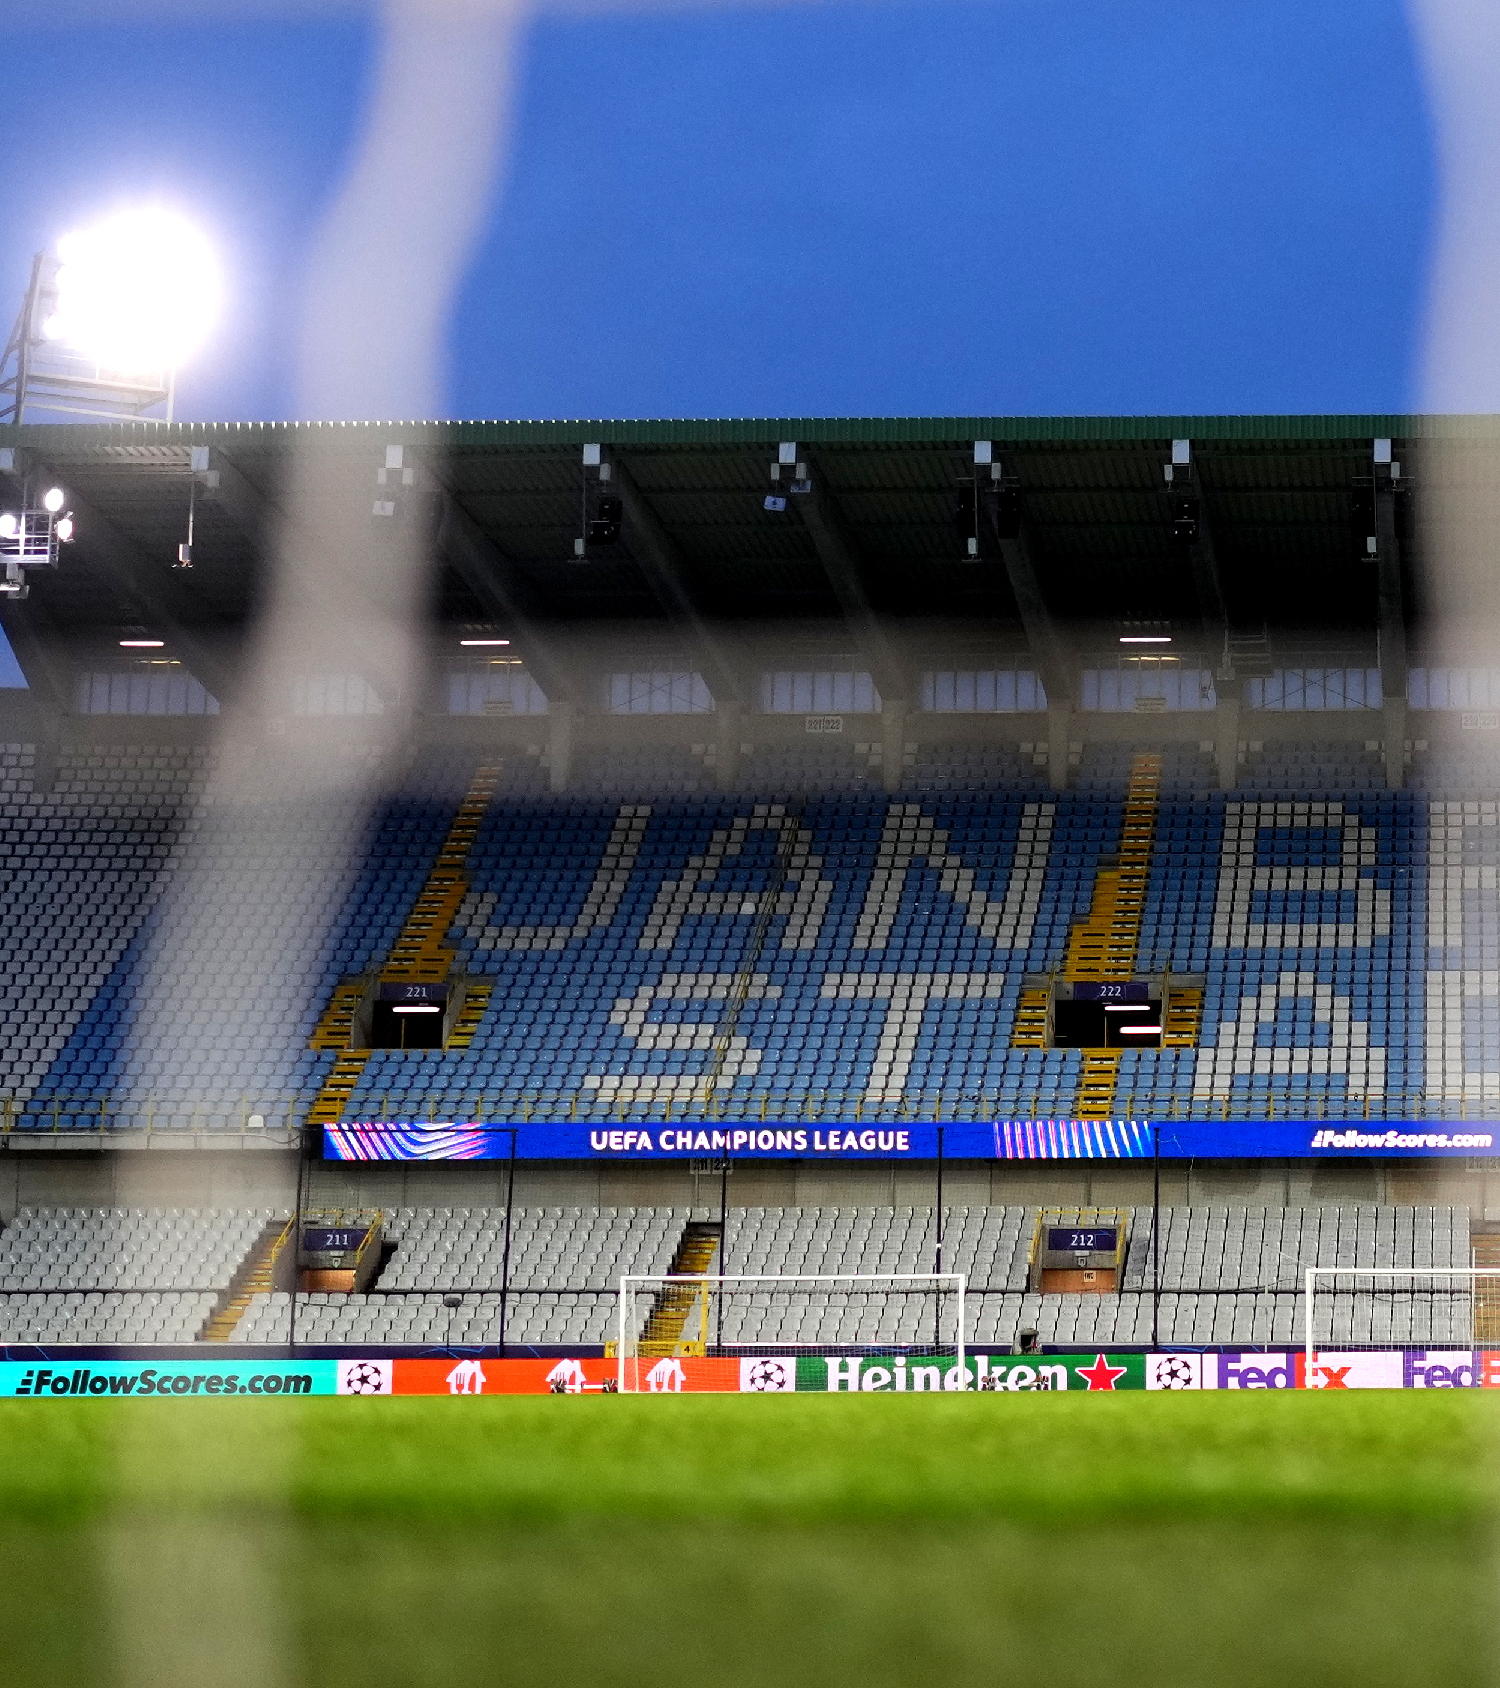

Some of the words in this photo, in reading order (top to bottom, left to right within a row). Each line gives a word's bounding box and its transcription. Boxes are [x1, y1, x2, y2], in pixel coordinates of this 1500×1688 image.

[451, 804, 1056, 951] JAN
[406, 986, 428, 998] 221
[1100, 985, 1122, 997] 222
[590, 1130, 653, 1151] UEFA
[658, 1130, 808, 1151] CHAMPIONS
[813, 1130, 910, 1151] LEAGUE
[326, 1233, 349, 1246] 211
[1070, 1234, 1094, 1247] 212
[824, 1355, 1069, 1391] Heineken
[1218, 1352, 1353, 1389] FedEx
